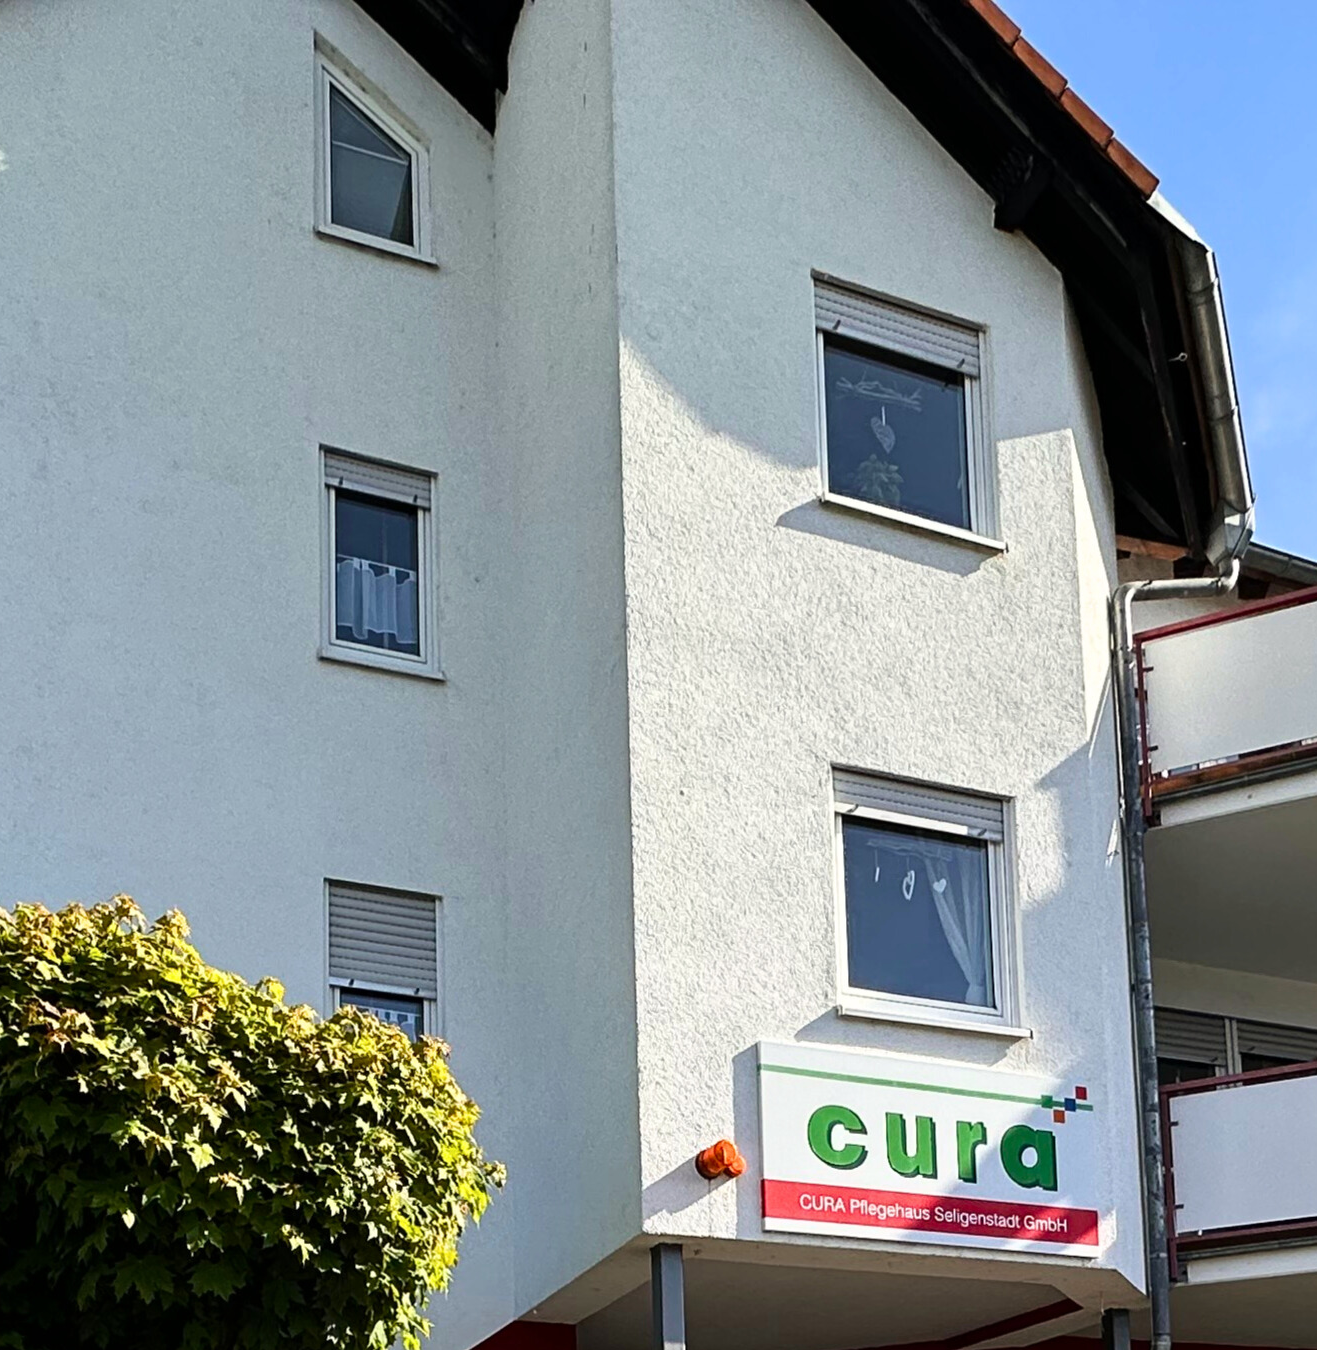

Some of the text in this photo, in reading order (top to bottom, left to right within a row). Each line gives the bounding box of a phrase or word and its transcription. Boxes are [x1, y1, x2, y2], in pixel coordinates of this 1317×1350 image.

[807, 1103, 1059, 1192] cura
[799, 1193, 1068, 1233] CURA Pflegehaus Seligenstadt GmbH
